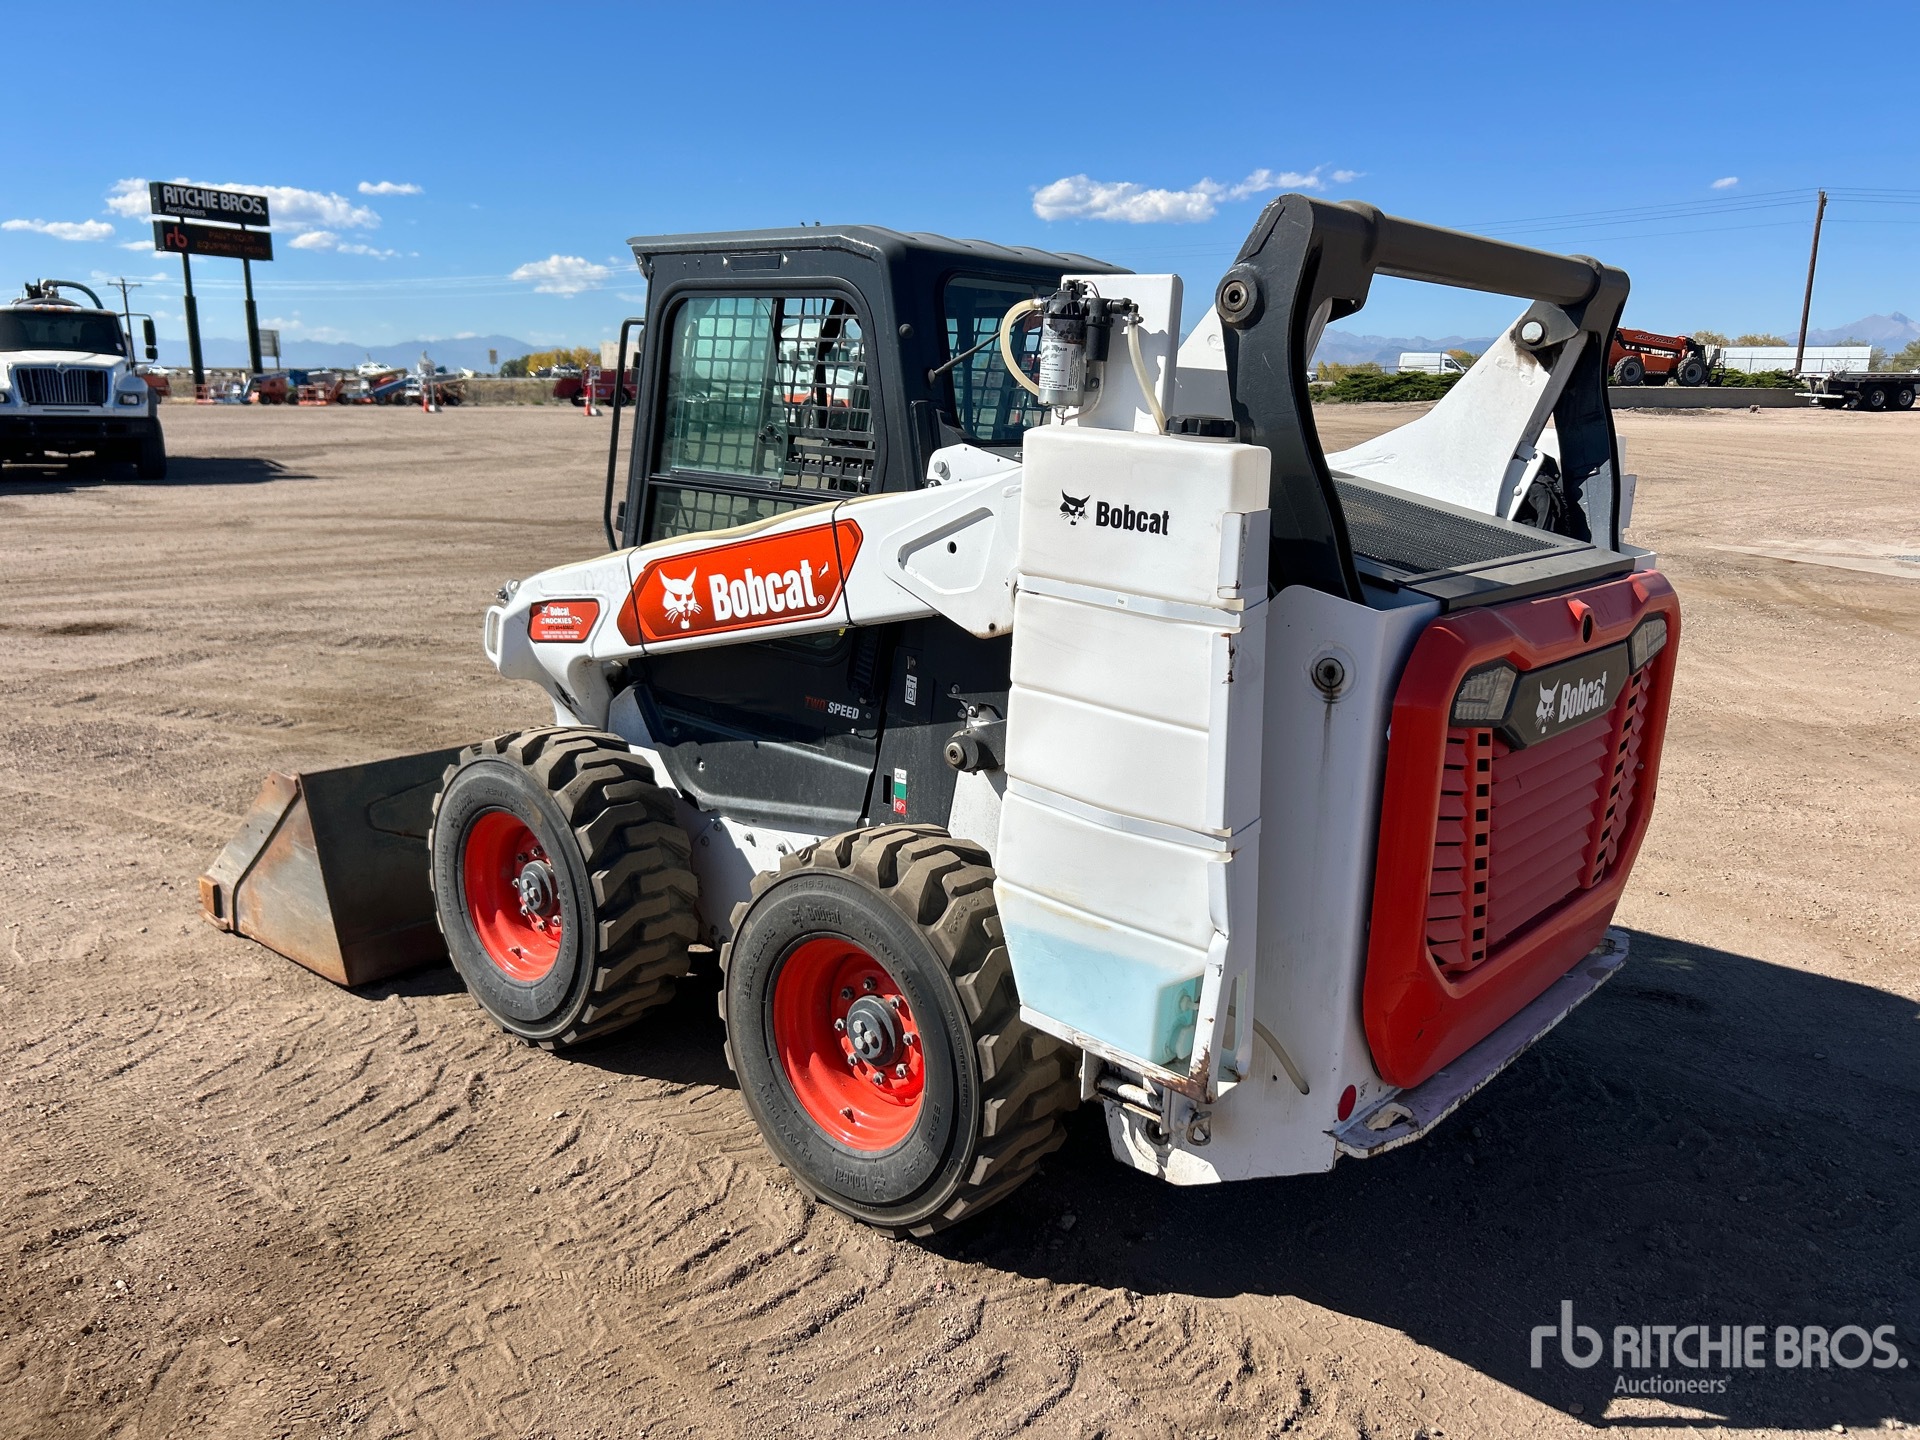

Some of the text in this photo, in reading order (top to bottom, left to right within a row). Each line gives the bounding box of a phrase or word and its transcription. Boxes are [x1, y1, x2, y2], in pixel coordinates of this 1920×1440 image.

[162, 185, 266, 216] RITCHIE BROS.
[165, 204, 207, 217] Auctioneers
[166, 225, 188, 248] rb
[1634, 334, 1677, 345] SKYTRAK
[1095, 500, 1170, 536] Bobcat
[708, 559, 819, 622] Bobcat
[545, 617, 572, 625] ROCKIES
[549, 606, 570, 616] Bobcat
[805, 696, 860, 720] TWO SPEED
[1558, 670, 1608, 723] Bobcat
[806, 904, 842, 926] Bobcat
